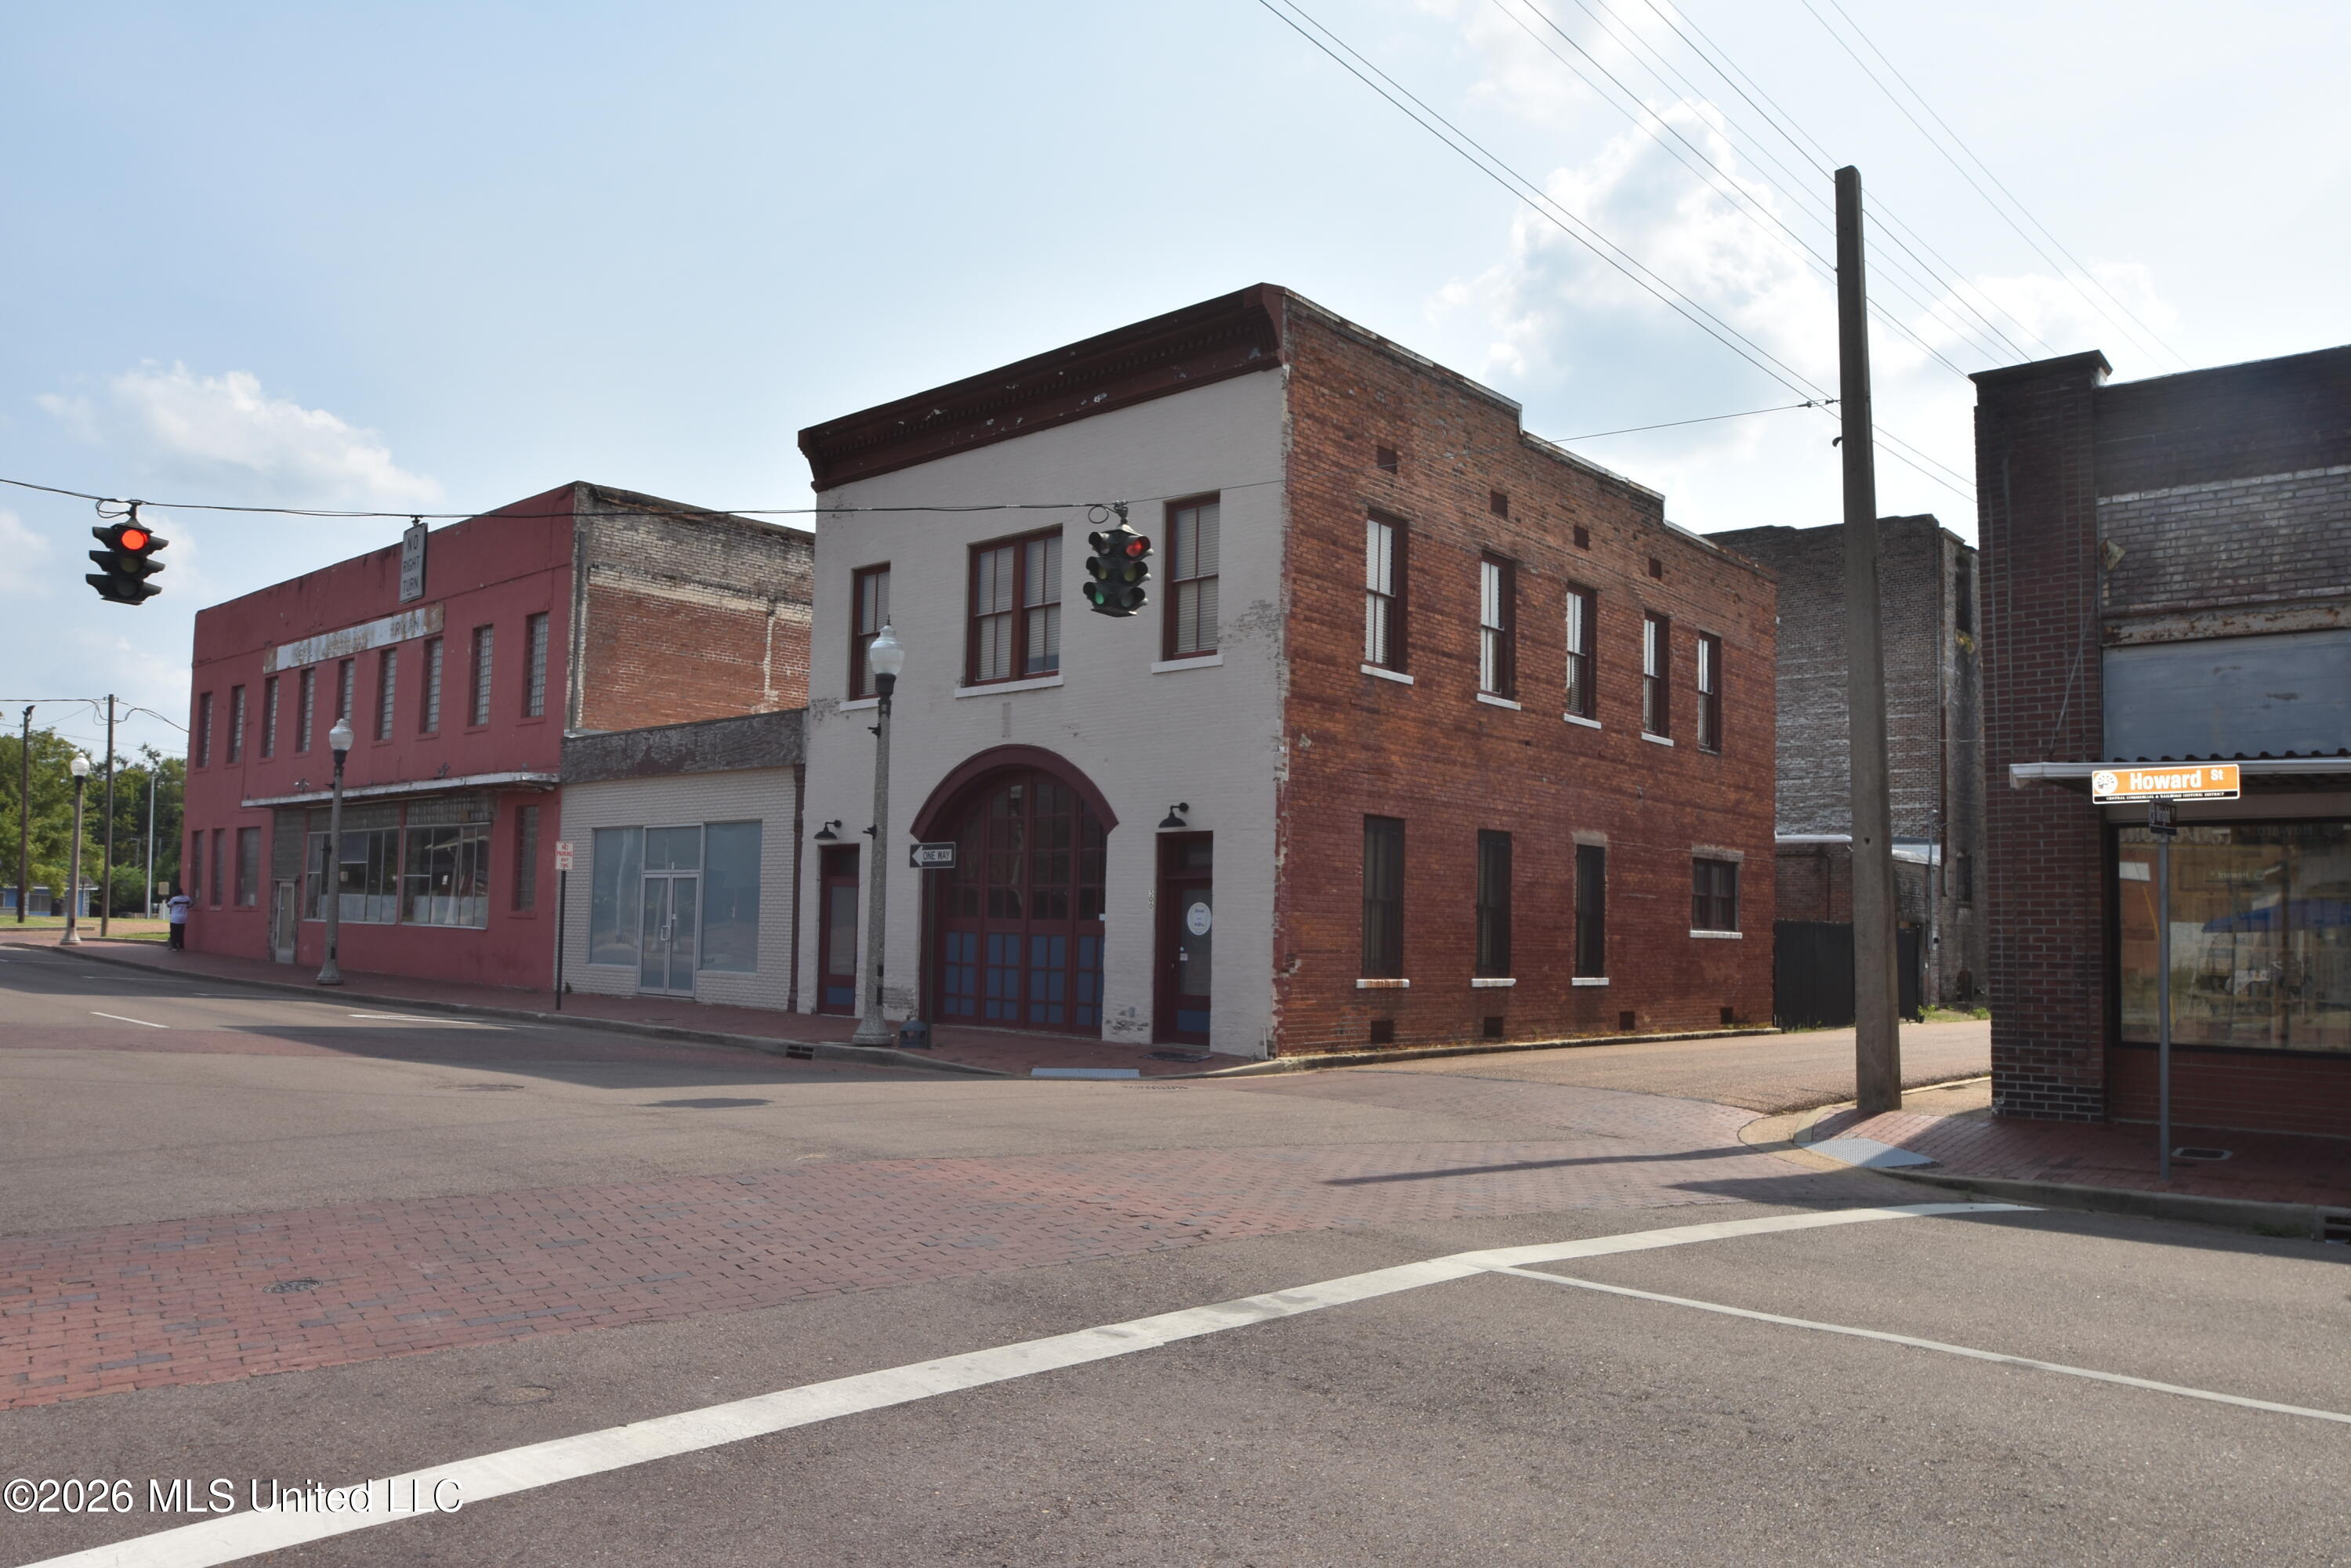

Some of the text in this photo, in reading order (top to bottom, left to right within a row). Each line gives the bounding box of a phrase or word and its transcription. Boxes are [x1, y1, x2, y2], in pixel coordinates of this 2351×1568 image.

[408, 534, 418, 552] NO
[403, 556, 420, 573] RIGHT
[403, 576, 418, 593] TURN
[2129, 769, 2224, 791] Howard St
[922, 850, 951, 860] ONE WAY
